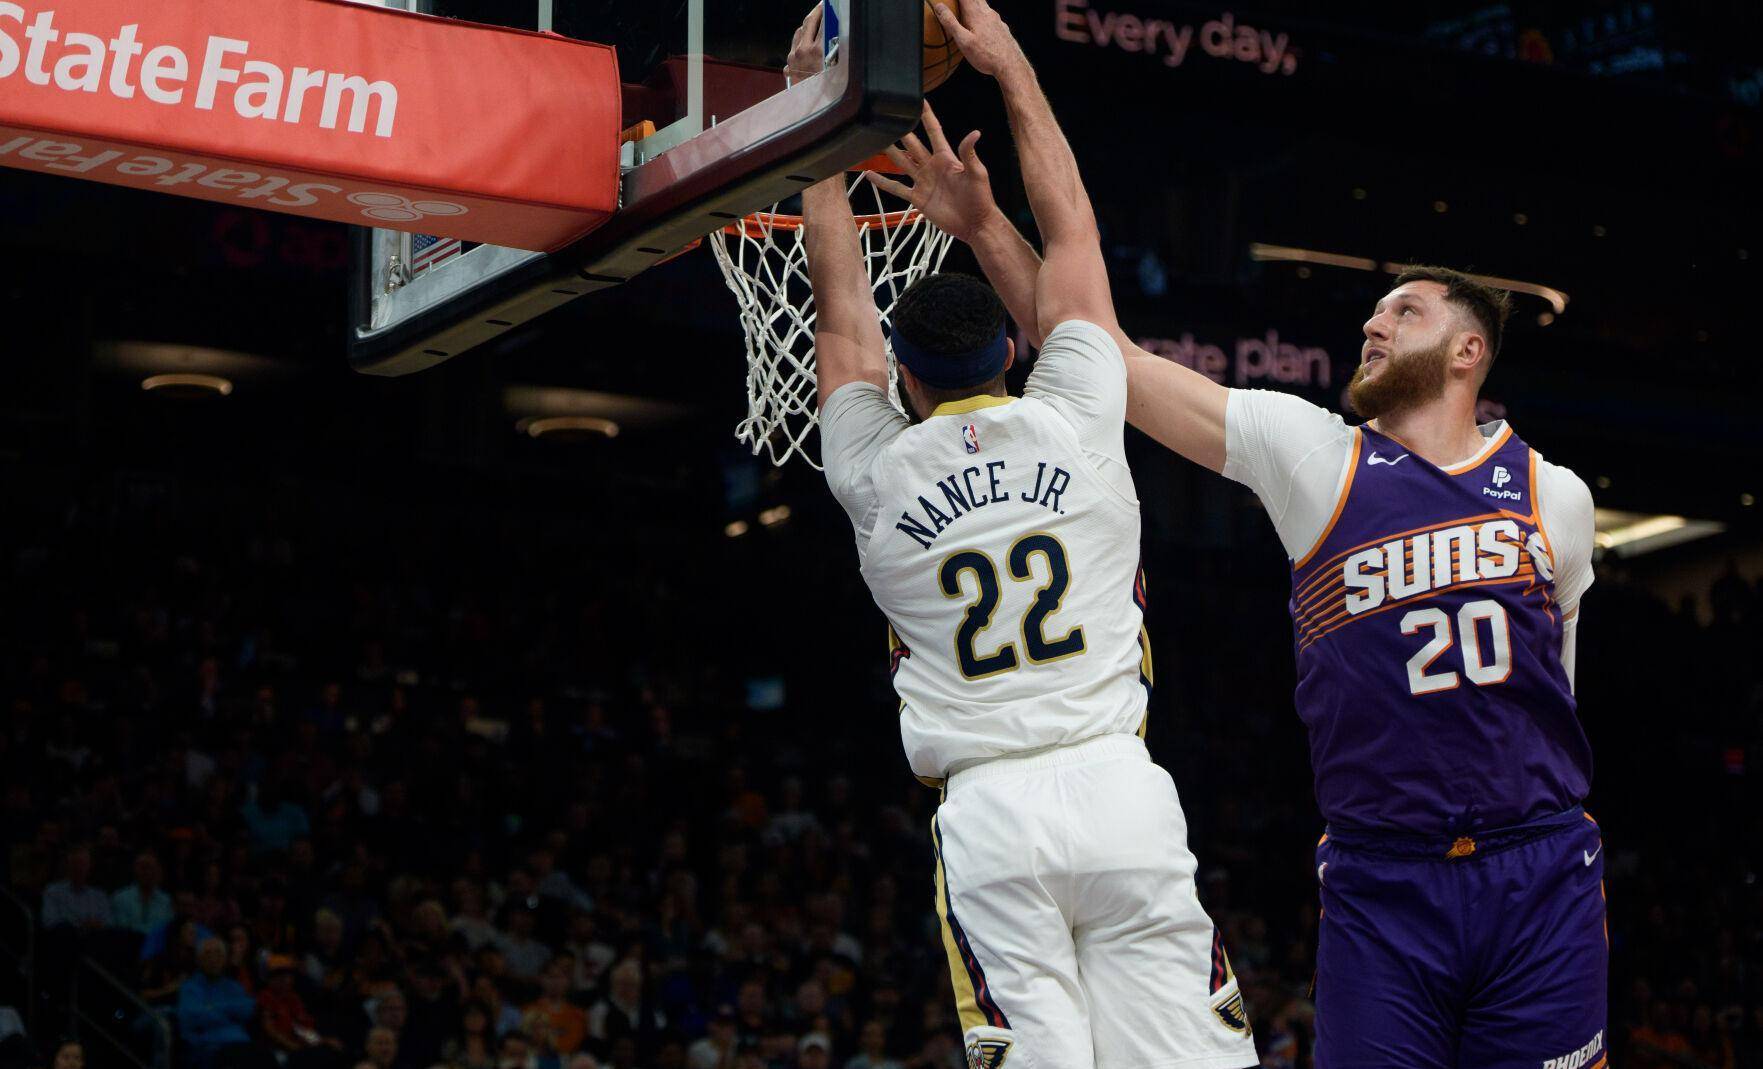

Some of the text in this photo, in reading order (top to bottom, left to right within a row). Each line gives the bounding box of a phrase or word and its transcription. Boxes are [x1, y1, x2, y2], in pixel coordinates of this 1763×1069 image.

[1056, 0, 1298, 76] Every day,
[1235, 327, 1332, 390] plan
[895, 460, 1071, 550] NANCE JR.
[1483, 486, 1522, 501] PayPal
[937, 530, 1088, 682] 22
[1400, 599, 1513, 696] 20
